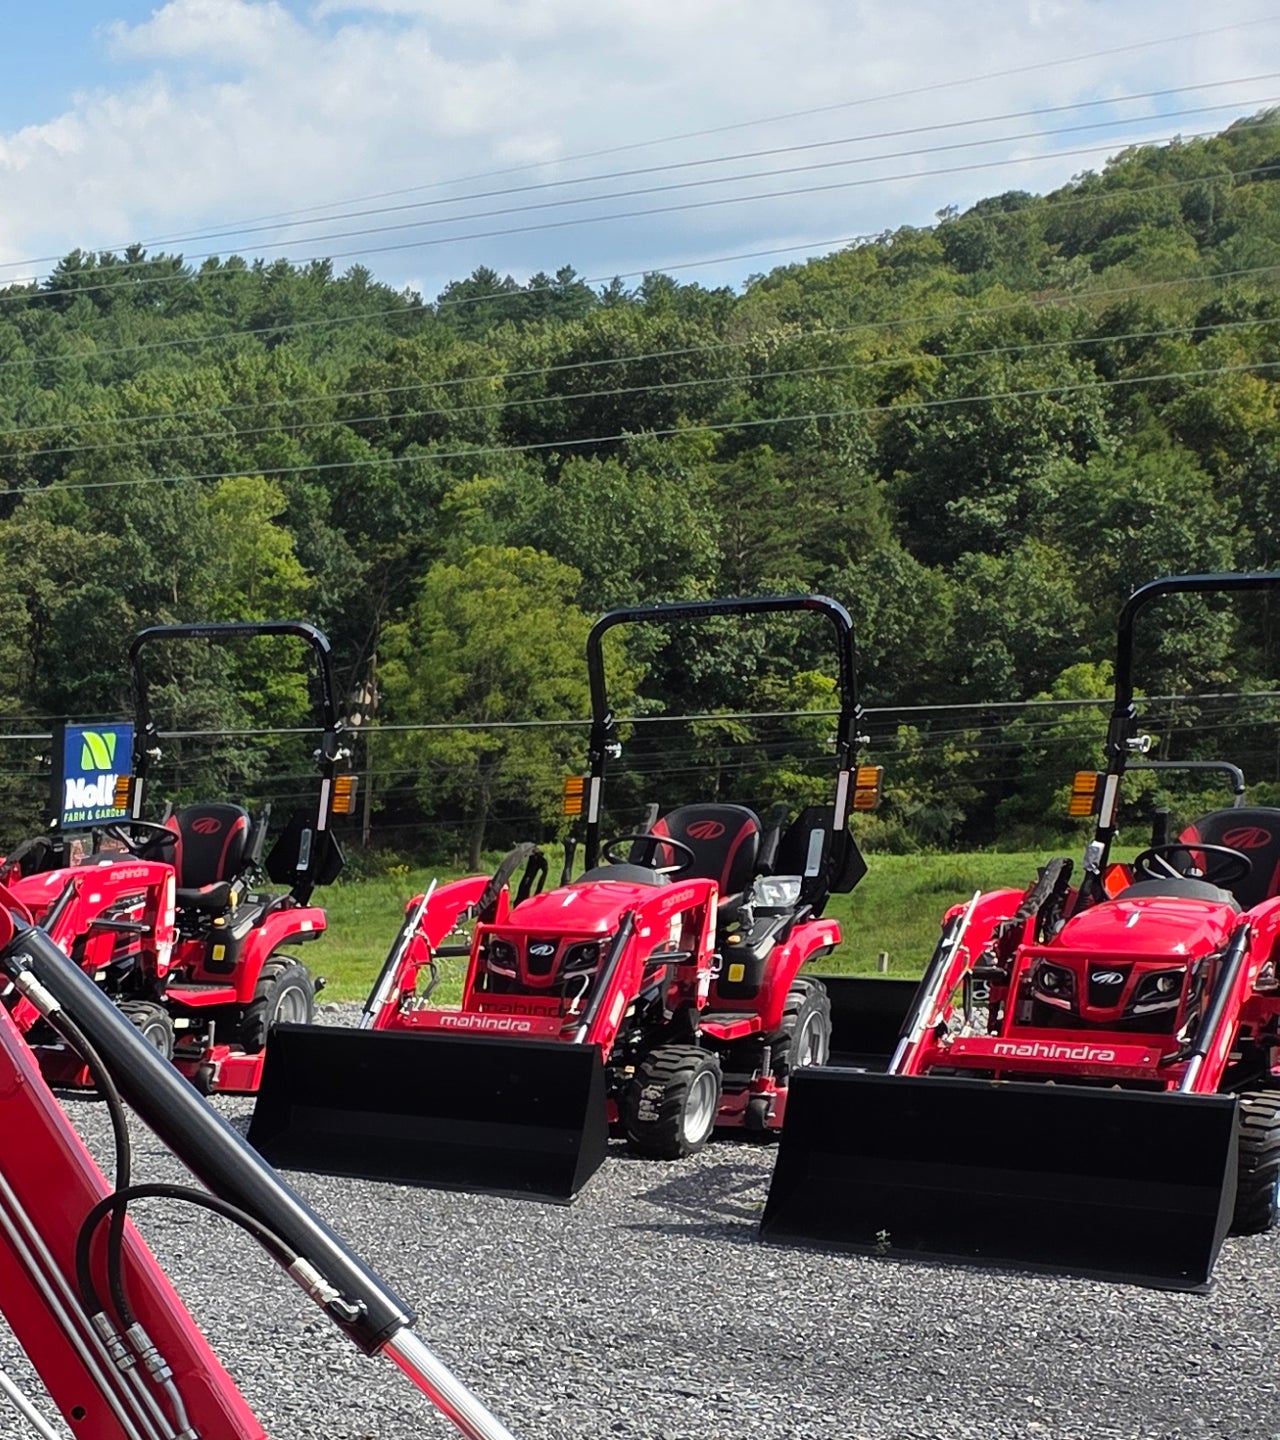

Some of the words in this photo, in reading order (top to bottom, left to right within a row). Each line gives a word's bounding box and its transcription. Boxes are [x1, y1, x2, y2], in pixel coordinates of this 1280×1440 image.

[63, 810, 85, 823] FARM
[95, 808, 126, 820] GARDEN
[440, 1014, 531, 1031] mahindra
[993, 1043, 1115, 1061] mahindra
